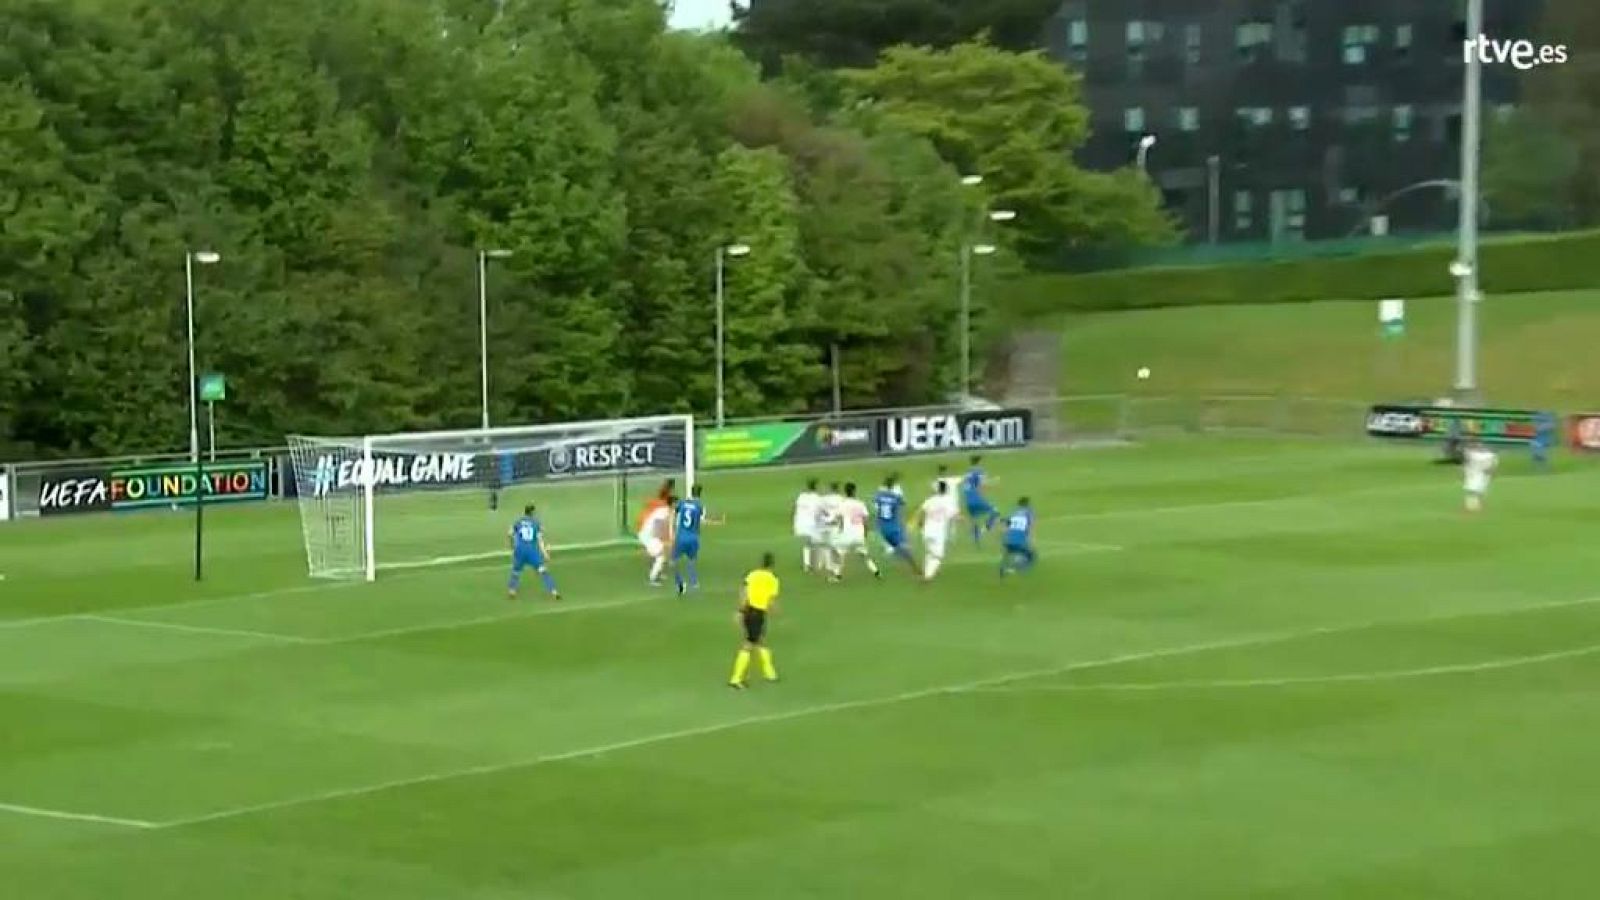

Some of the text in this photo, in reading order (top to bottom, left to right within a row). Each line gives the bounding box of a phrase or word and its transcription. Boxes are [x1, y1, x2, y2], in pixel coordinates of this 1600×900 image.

[887, 413, 1025, 451] UEFA.com
[575, 441, 656, 468] RESPECT
[40, 471, 265, 507] UEFA FOUNDATION
